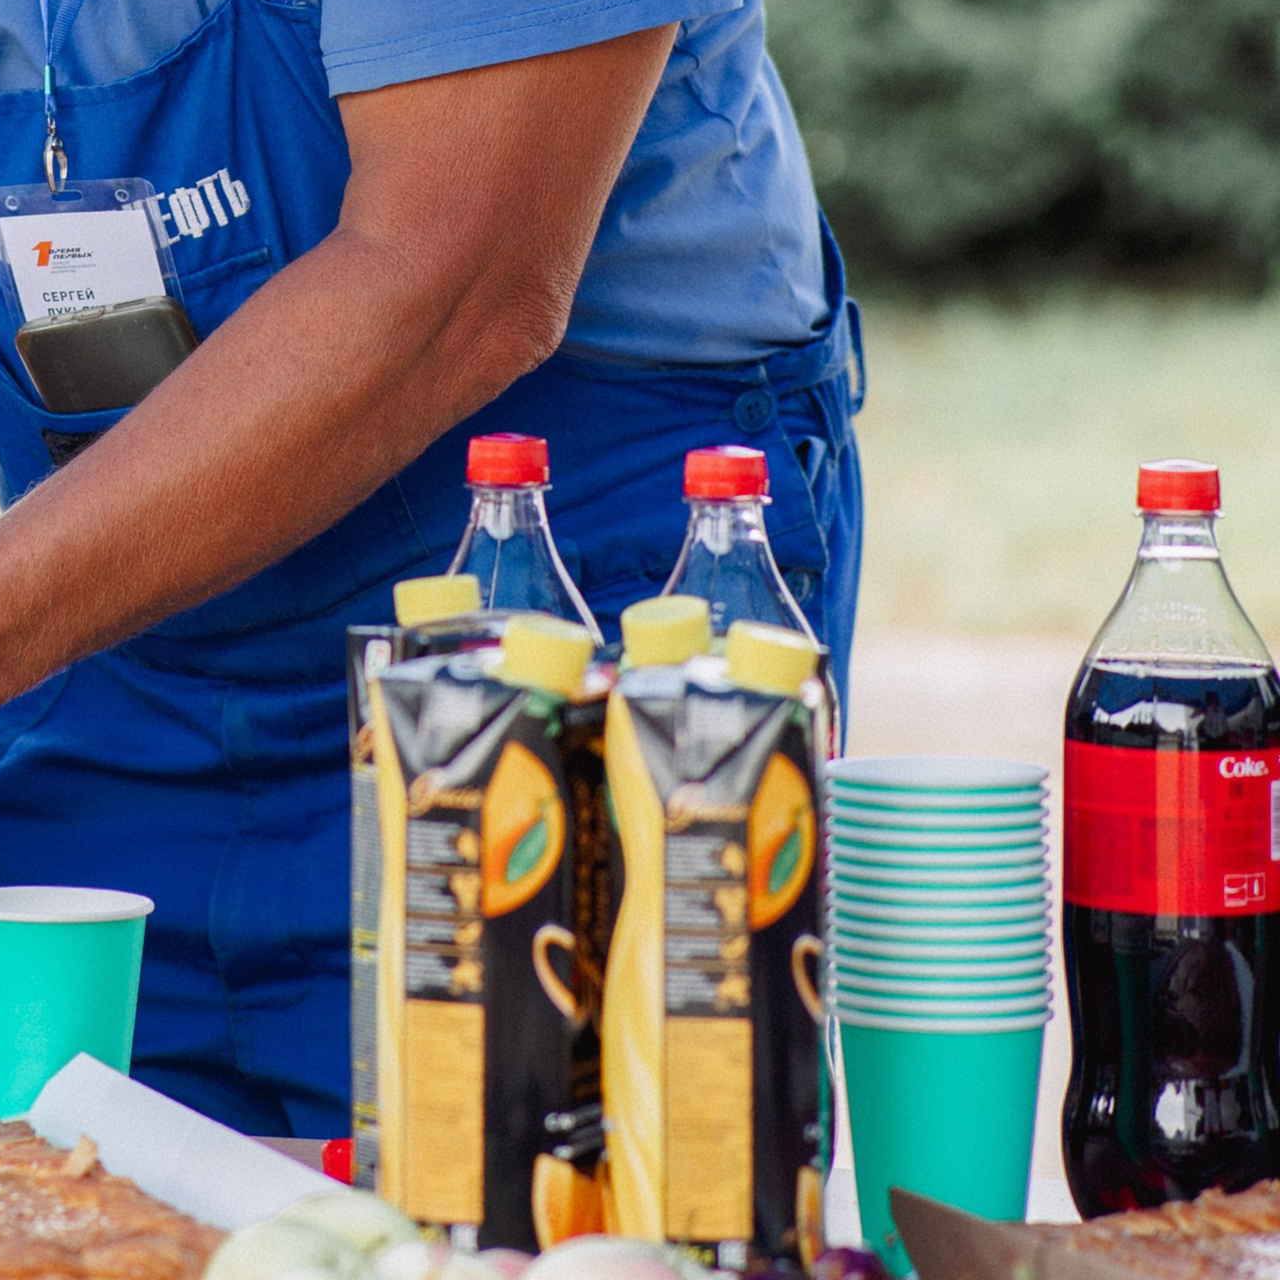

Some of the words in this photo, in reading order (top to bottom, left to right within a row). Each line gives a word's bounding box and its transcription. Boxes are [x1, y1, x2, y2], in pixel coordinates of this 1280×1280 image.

[49, 247, 81, 255] ВРЕМЯ
[53, 252, 93, 260] ПЕРВЫХ
[42, 288, 95, 303] СЕРГЕЙ
